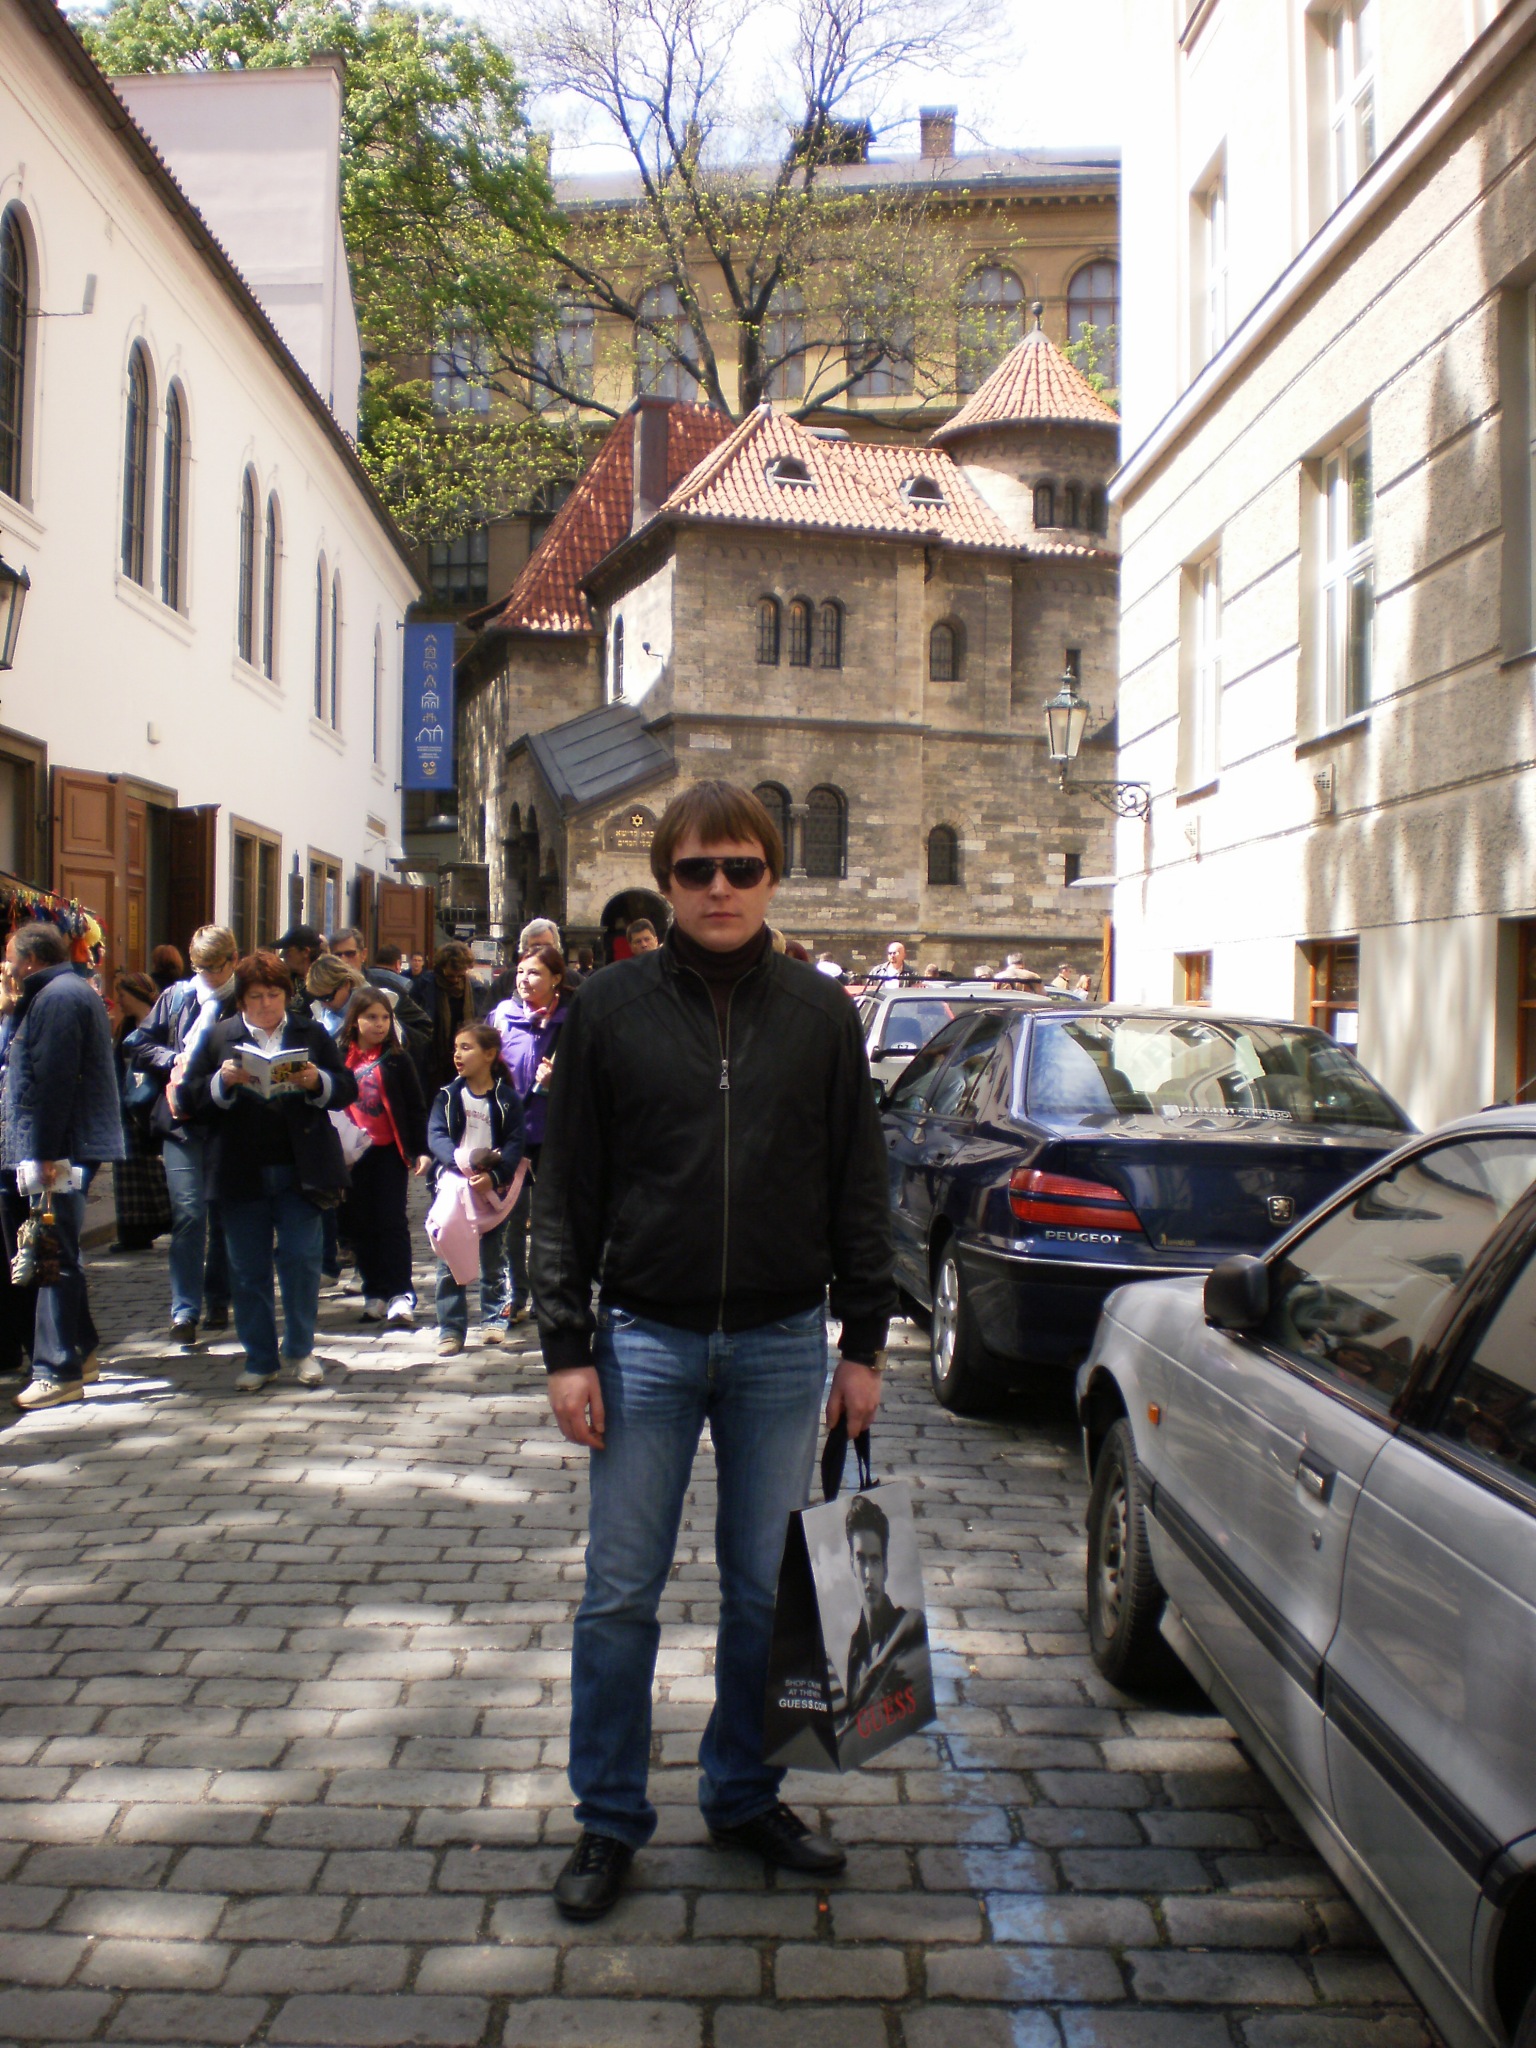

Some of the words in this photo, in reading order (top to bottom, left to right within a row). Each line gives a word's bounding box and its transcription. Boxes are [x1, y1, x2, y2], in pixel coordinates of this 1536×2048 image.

[1045, 1230, 1122, 1244] PEUGEOT
[779, 1698, 828, 1712] GUESS.COM
[856, 1685, 917, 1739] GUESS
